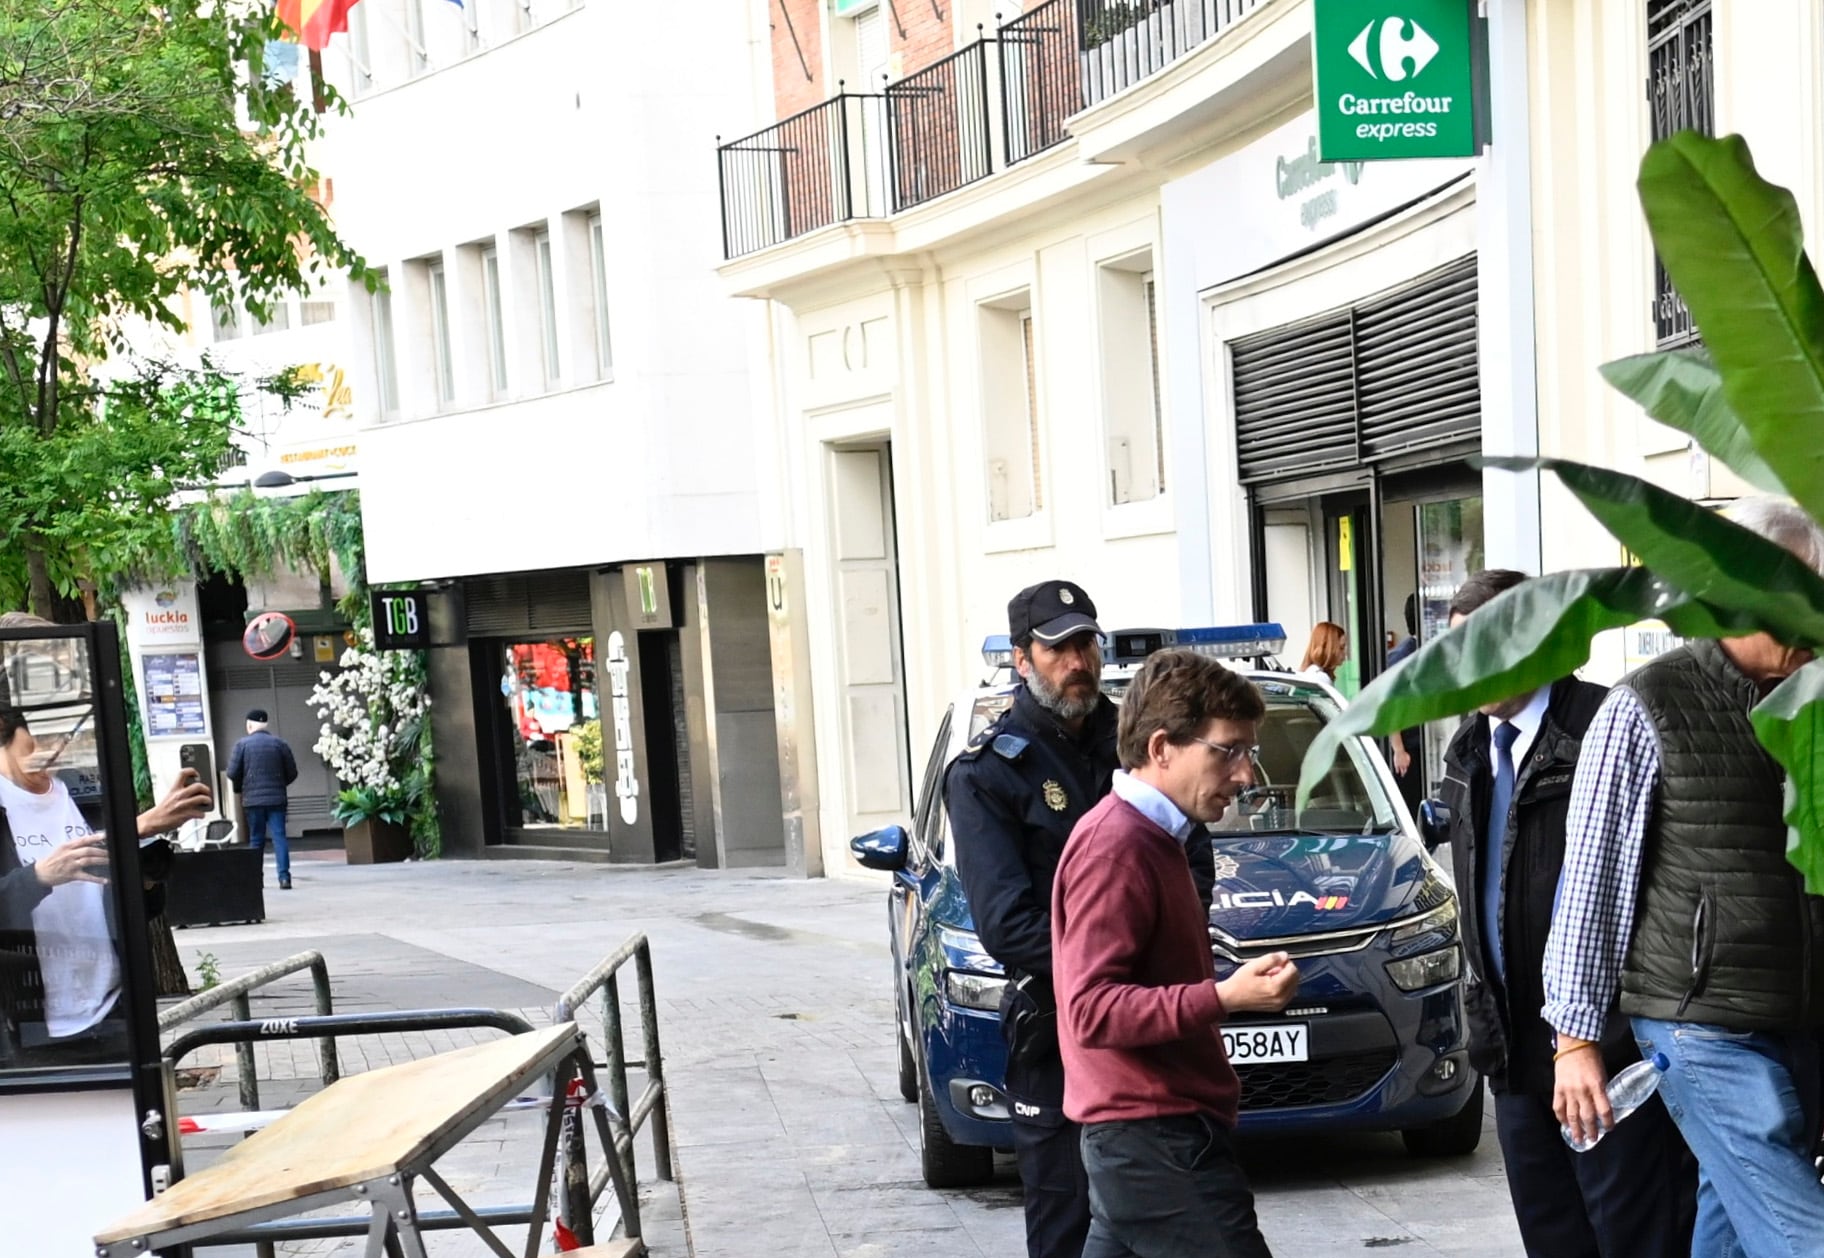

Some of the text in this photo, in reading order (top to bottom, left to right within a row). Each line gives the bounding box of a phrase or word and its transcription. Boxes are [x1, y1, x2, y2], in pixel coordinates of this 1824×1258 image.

[1338, 91, 1453, 116] Carrefour
[1355, 122, 1438, 143] express
[145, 610, 189, 625] luckia
[381, 597, 419, 635] TGB
[15, 834, 53, 848] OCA
[260, 1019, 299, 1034] ZOXE
[1015, 1102, 1041, 1118] CNP
